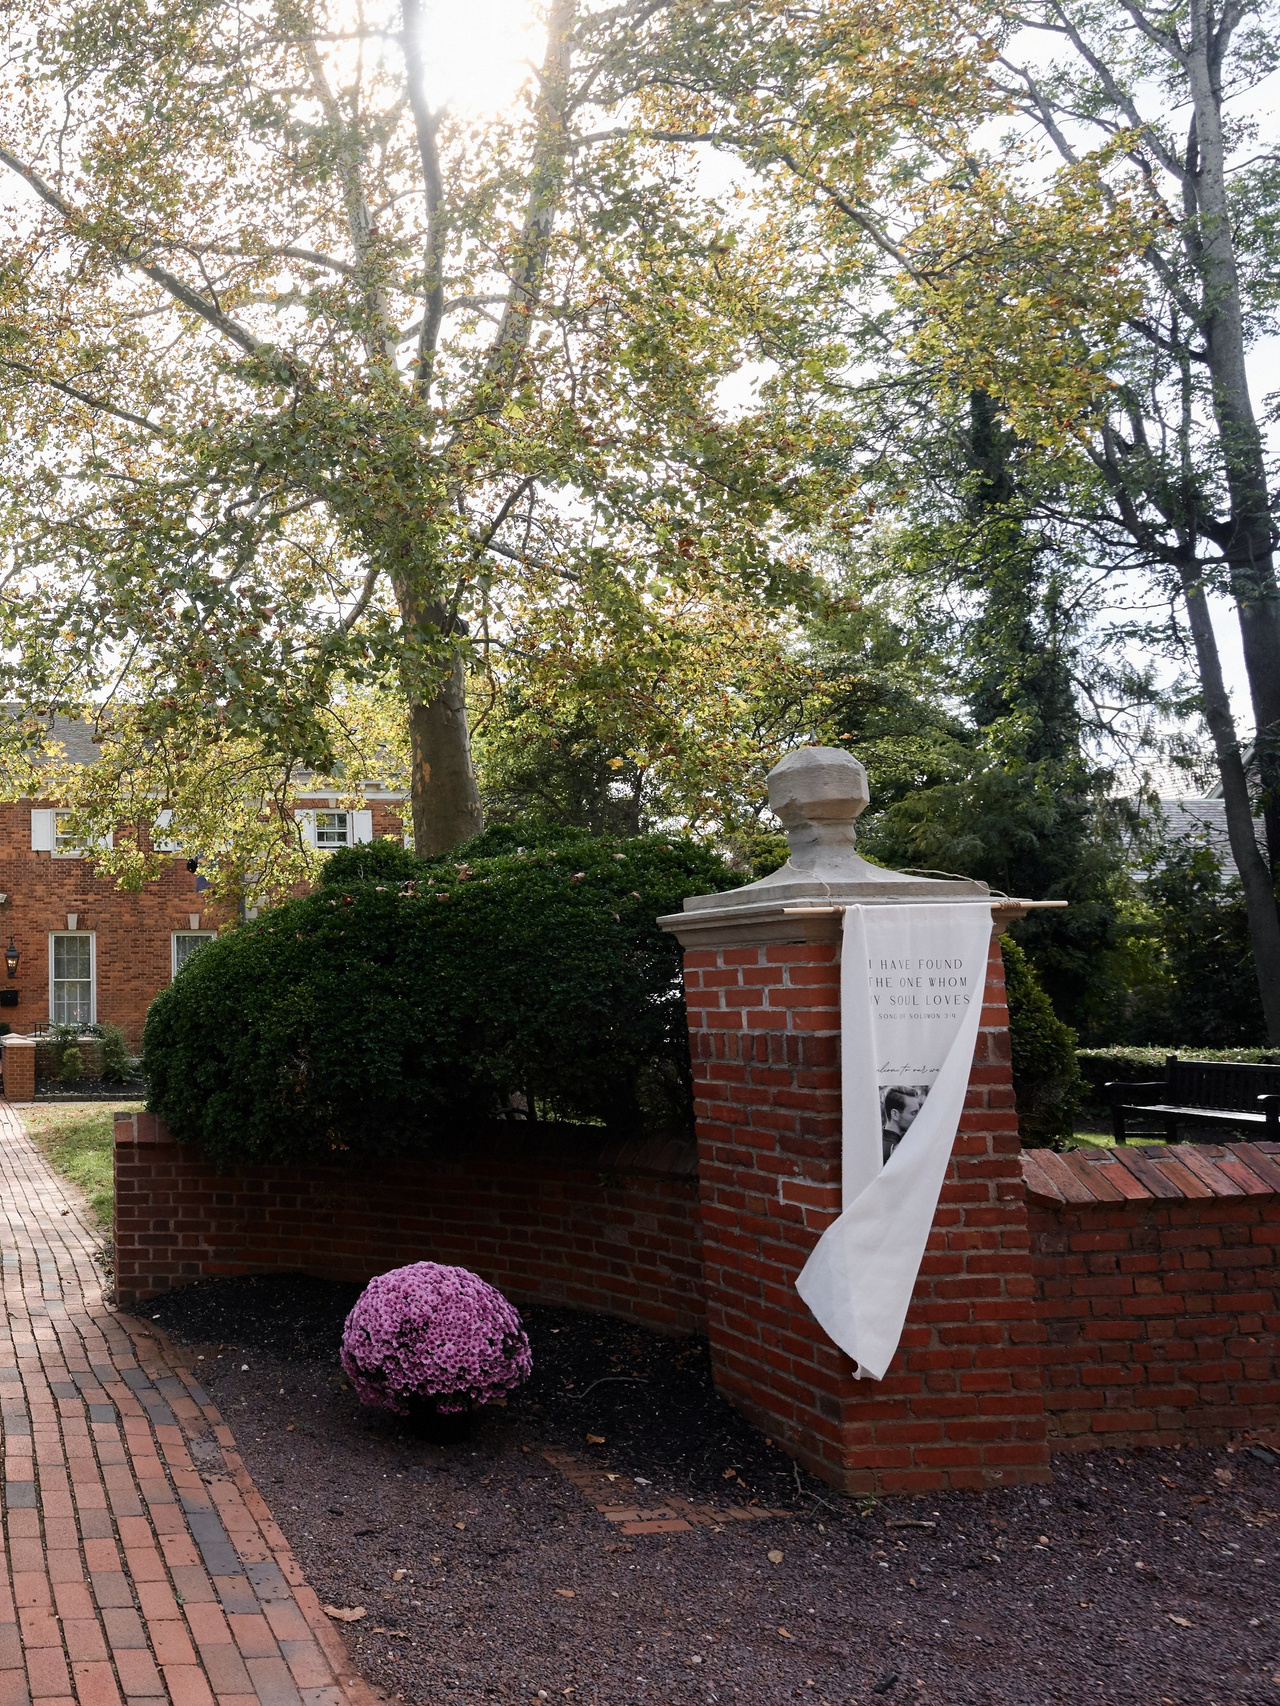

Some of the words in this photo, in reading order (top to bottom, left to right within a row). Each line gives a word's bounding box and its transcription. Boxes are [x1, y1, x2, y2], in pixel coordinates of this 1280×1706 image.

[880, 959, 911, 970] HAVE
[918, 959, 963, 970] FOUND
[900, 977, 922, 988] ONE
[928, 976, 967, 987] WHOM
[889, 995, 920, 1006] SOUL
[925, 994, 970, 1006] LOVES
[899, 1063, 910, 1076] to
